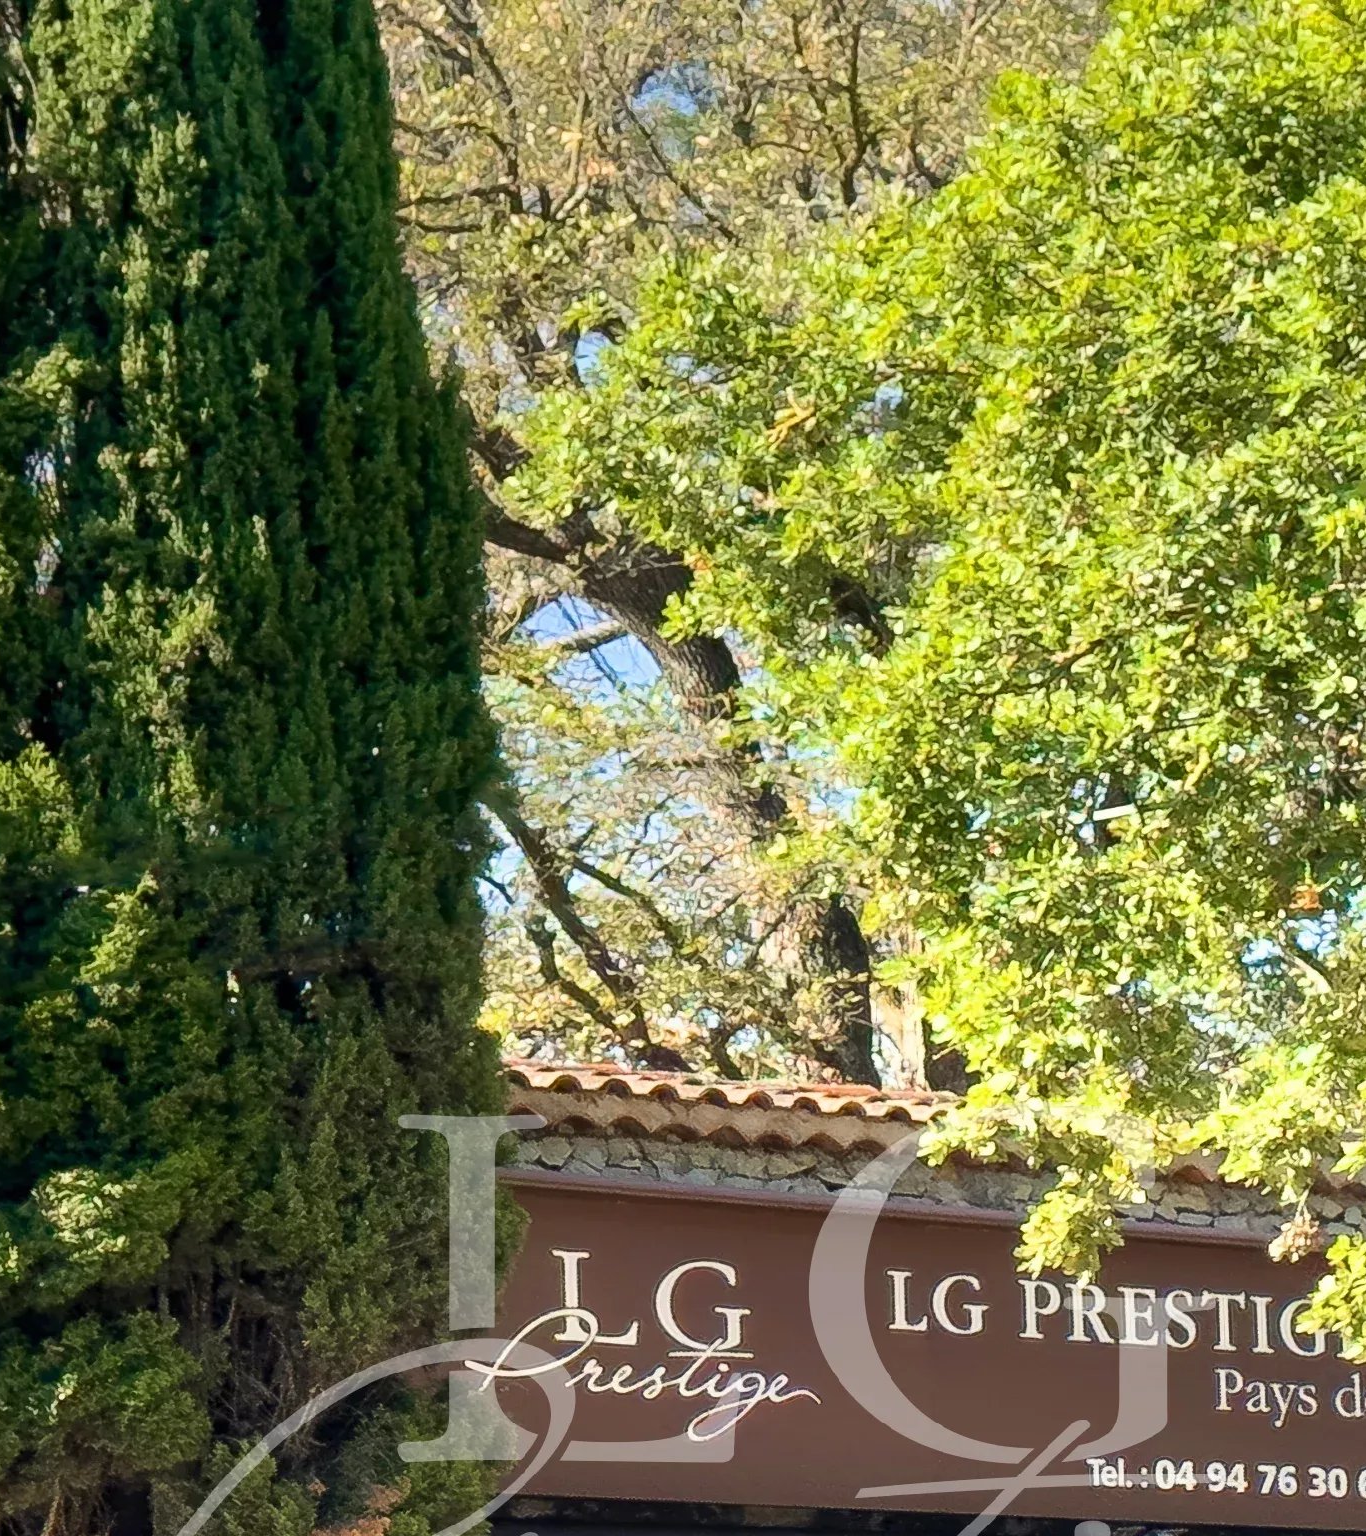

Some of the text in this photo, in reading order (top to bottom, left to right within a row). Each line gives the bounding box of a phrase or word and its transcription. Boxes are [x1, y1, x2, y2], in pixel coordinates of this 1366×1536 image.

[552, 1248, 751, 1353] LG
[885, 1268, 990, 1335] LG
[464, 1307, 822, 1442] Prestige
[1214, 1368, 1318, 1428] Pays
[1155, 1459, 1197, 1491] 04
[1206, 1460, 1248, 1493] 94
[1257, 1464, 1298, 1496] 76
[1307, 1467, 1348, 1498] 30
